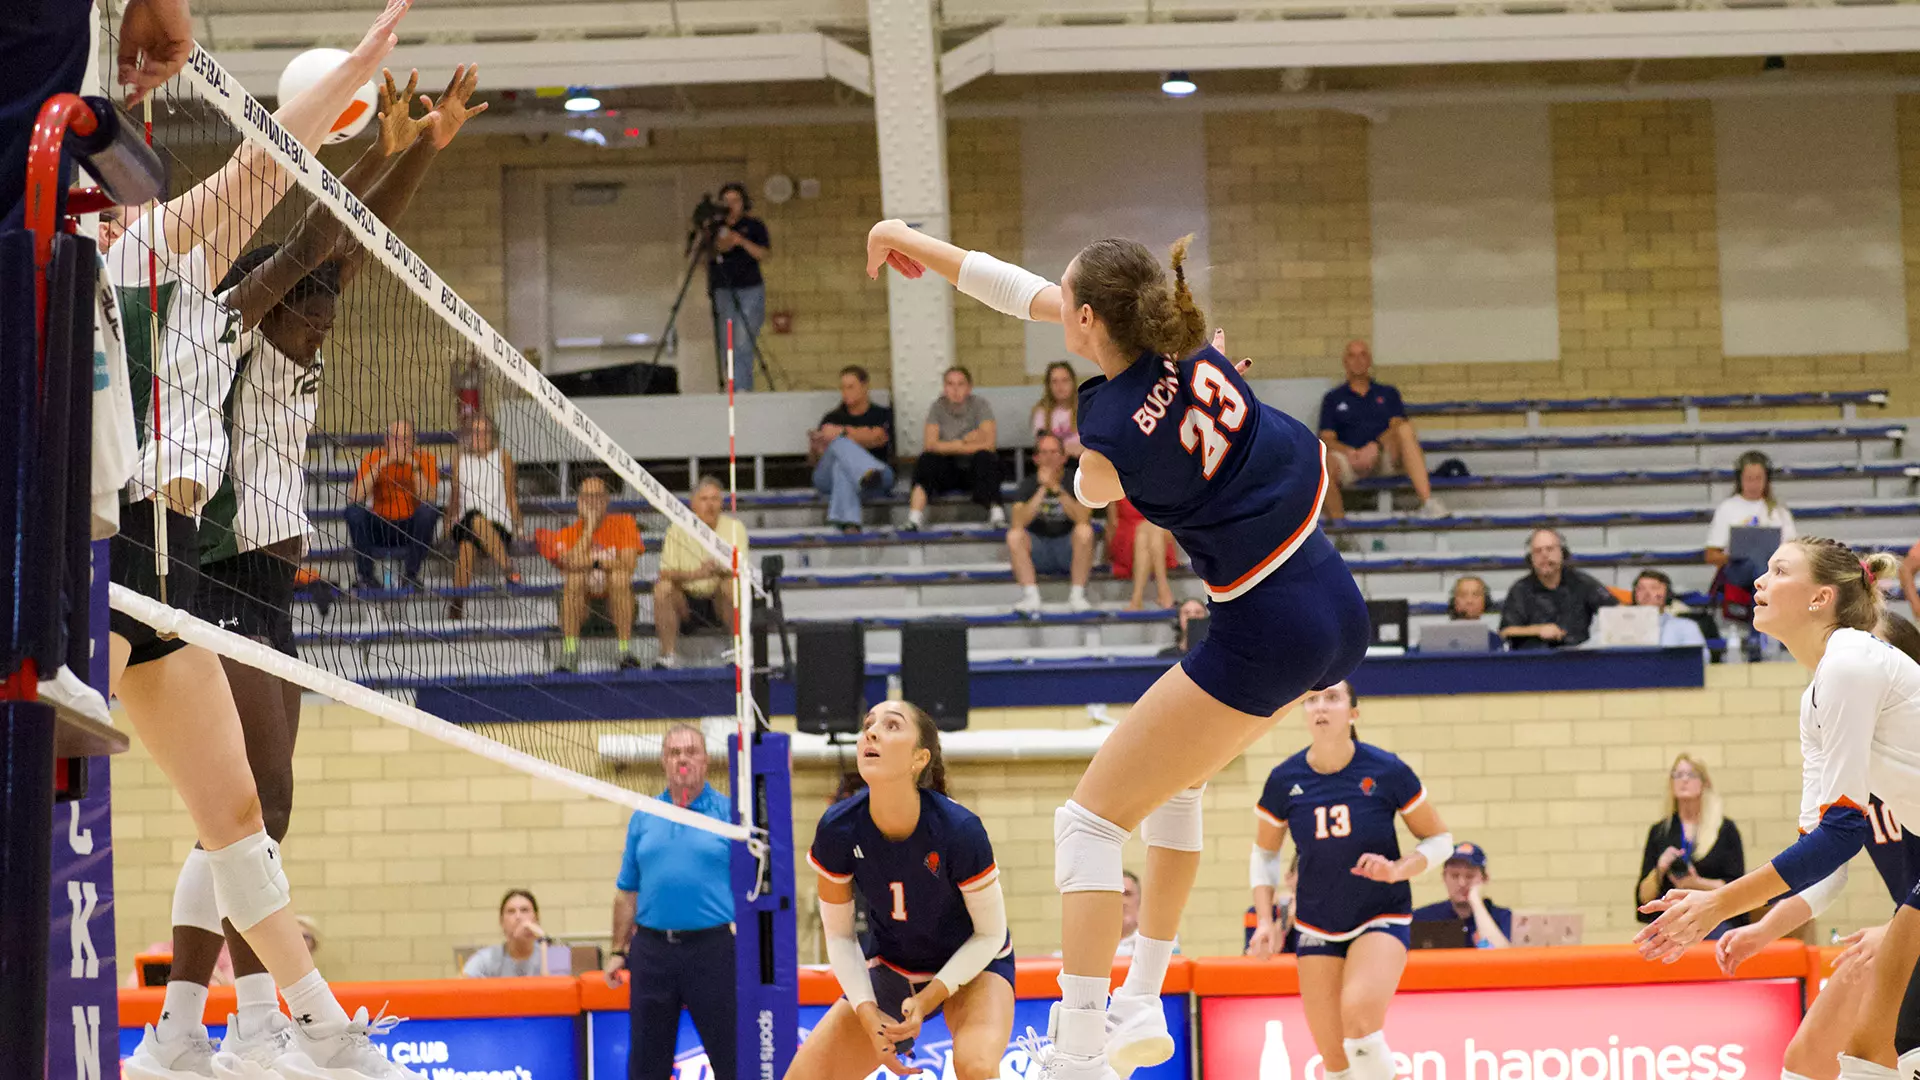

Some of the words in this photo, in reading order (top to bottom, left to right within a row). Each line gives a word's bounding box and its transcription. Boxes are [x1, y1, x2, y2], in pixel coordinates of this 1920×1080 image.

[1178, 360, 1248, 481] 23
[1313, 803, 1351, 840] 13
[1867, 803, 1903, 844] 10
[888, 881, 908, 922] 1
[391, 1041, 449, 1064] CLUB
[757, 1010, 775, 1061] sports
[1464, 1034, 1747, 1080] happiness
